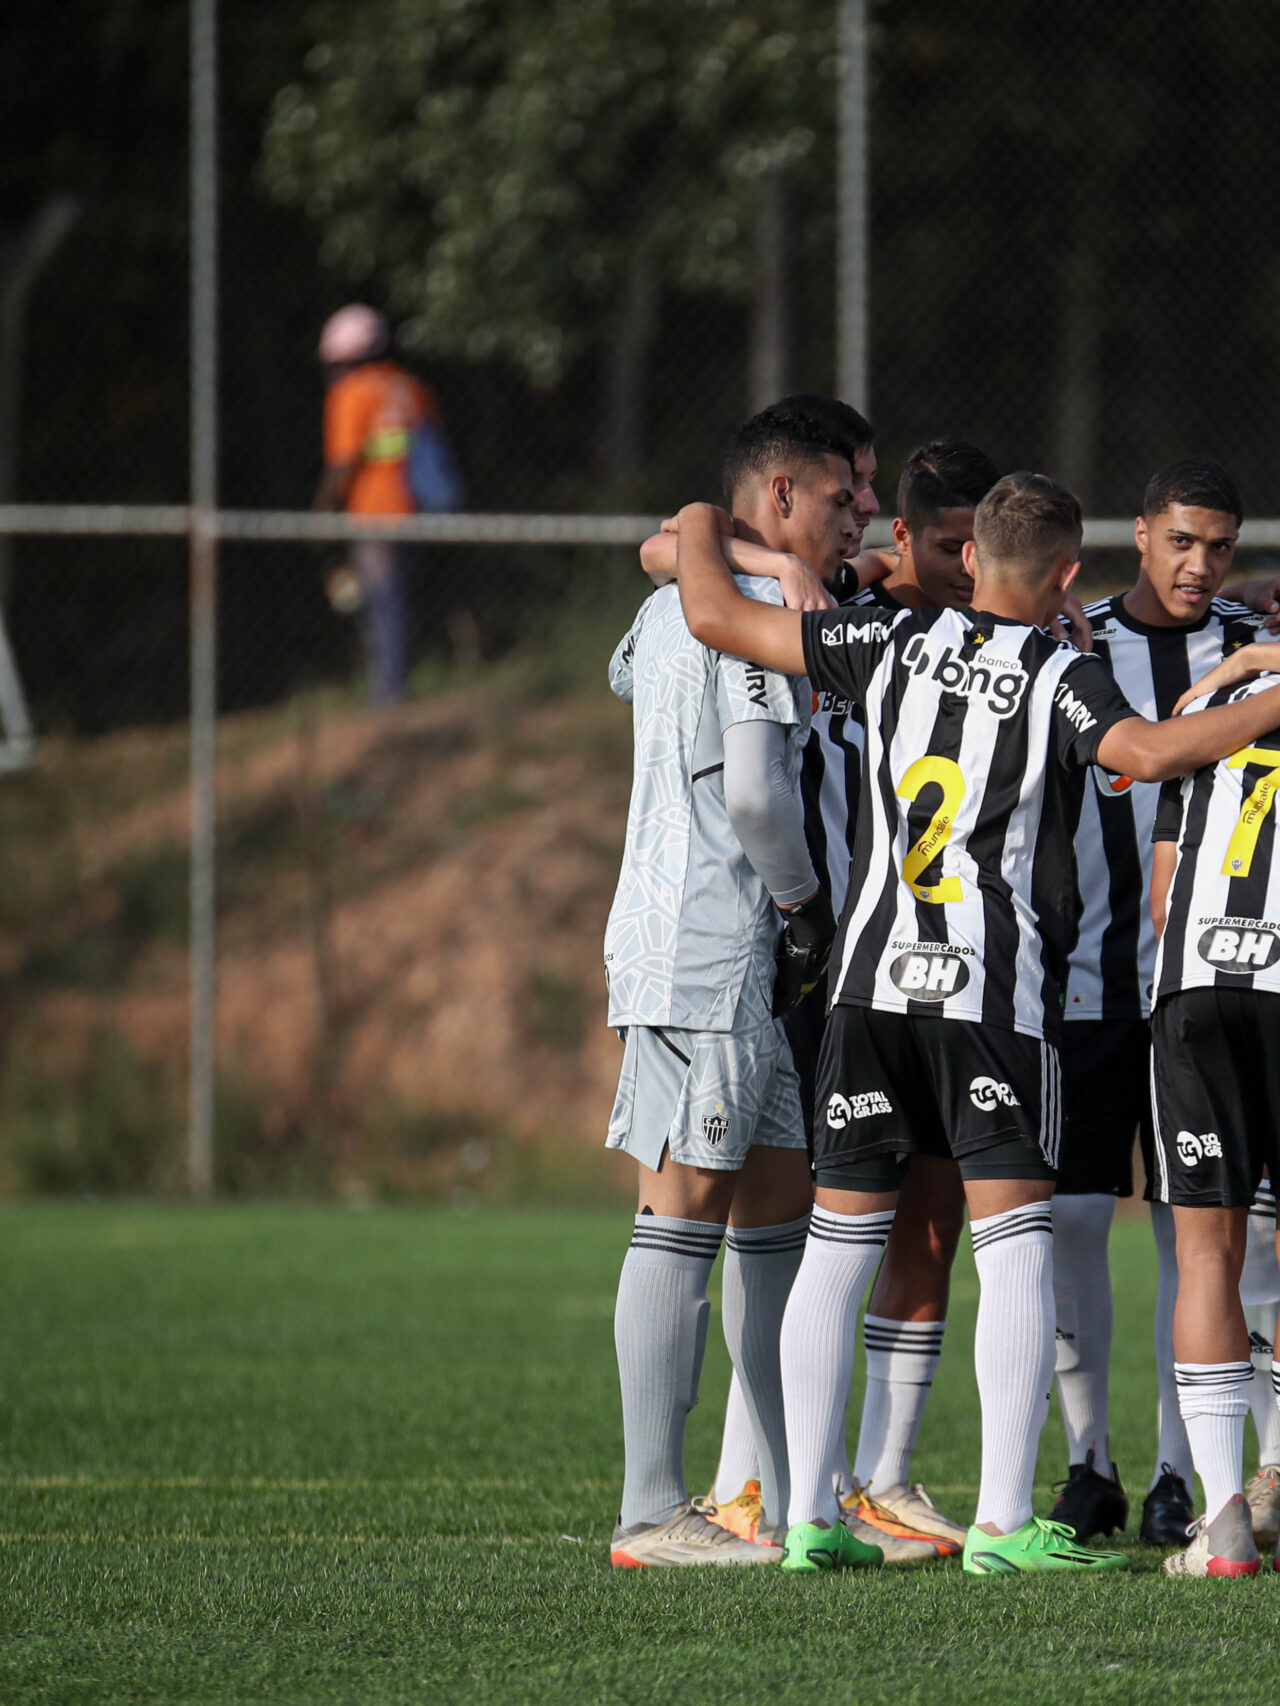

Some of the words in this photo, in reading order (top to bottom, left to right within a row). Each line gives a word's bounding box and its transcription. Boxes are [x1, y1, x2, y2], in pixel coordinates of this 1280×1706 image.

[978, 654, 1018, 670] banco
[1058, 690, 1098, 733] MRV
[894, 755, 966, 904] 2
[917, 816, 950, 856] mundale
[892, 941, 976, 956] SUPERMERCADOS
[1207, 929, 1275, 966] BH
[900, 955, 961, 992] BH
[849, 1091, 889, 1108] TOTAL
[853, 1102, 893, 1119] GRASS
[705, 1118, 727, 1127] CAM
